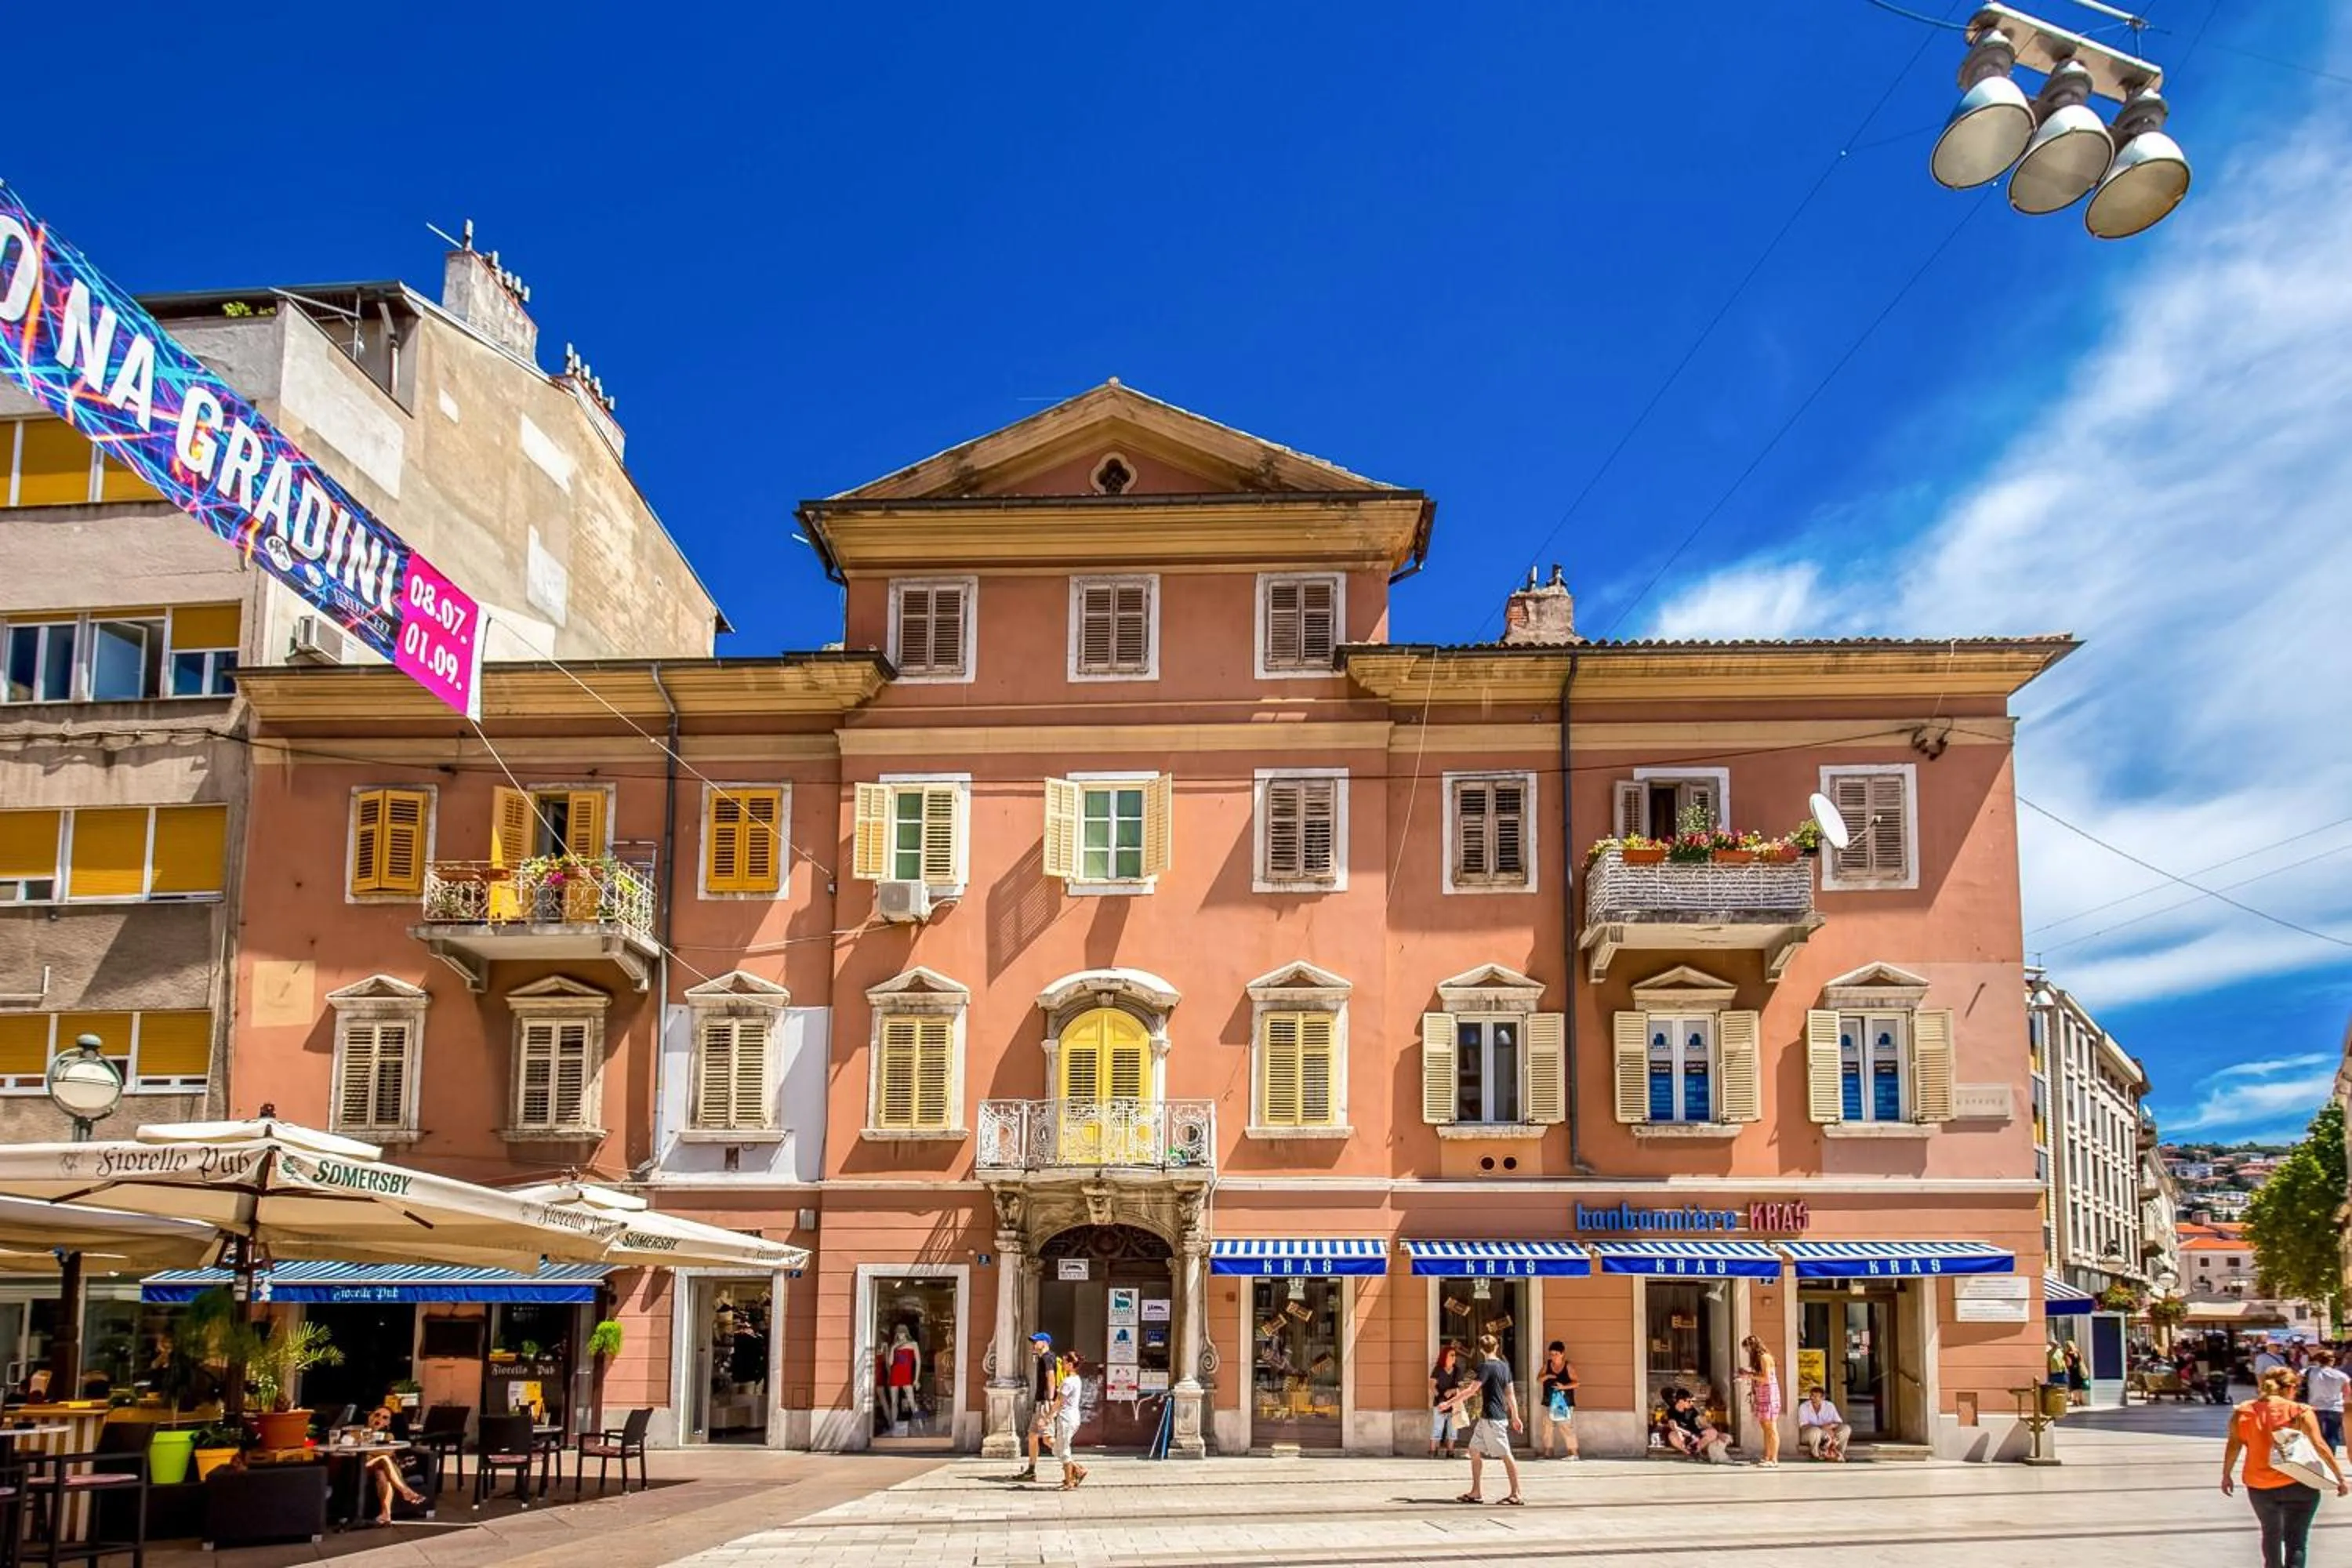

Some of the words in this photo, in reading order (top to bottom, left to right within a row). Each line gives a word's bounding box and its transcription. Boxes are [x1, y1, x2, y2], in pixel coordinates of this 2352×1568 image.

[55, 278, 155, 432] NA
[176, 387, 397, 618] GRADINI
[410, 575, 467, 644] 08.07.
[405, 622, 462, 690] 01.09.
[96, 1146, 188, 1177] Fiorello
[198, 1146, 251, 1182] Pub
[622, 1232, 680, 1250] SOMERSBY
